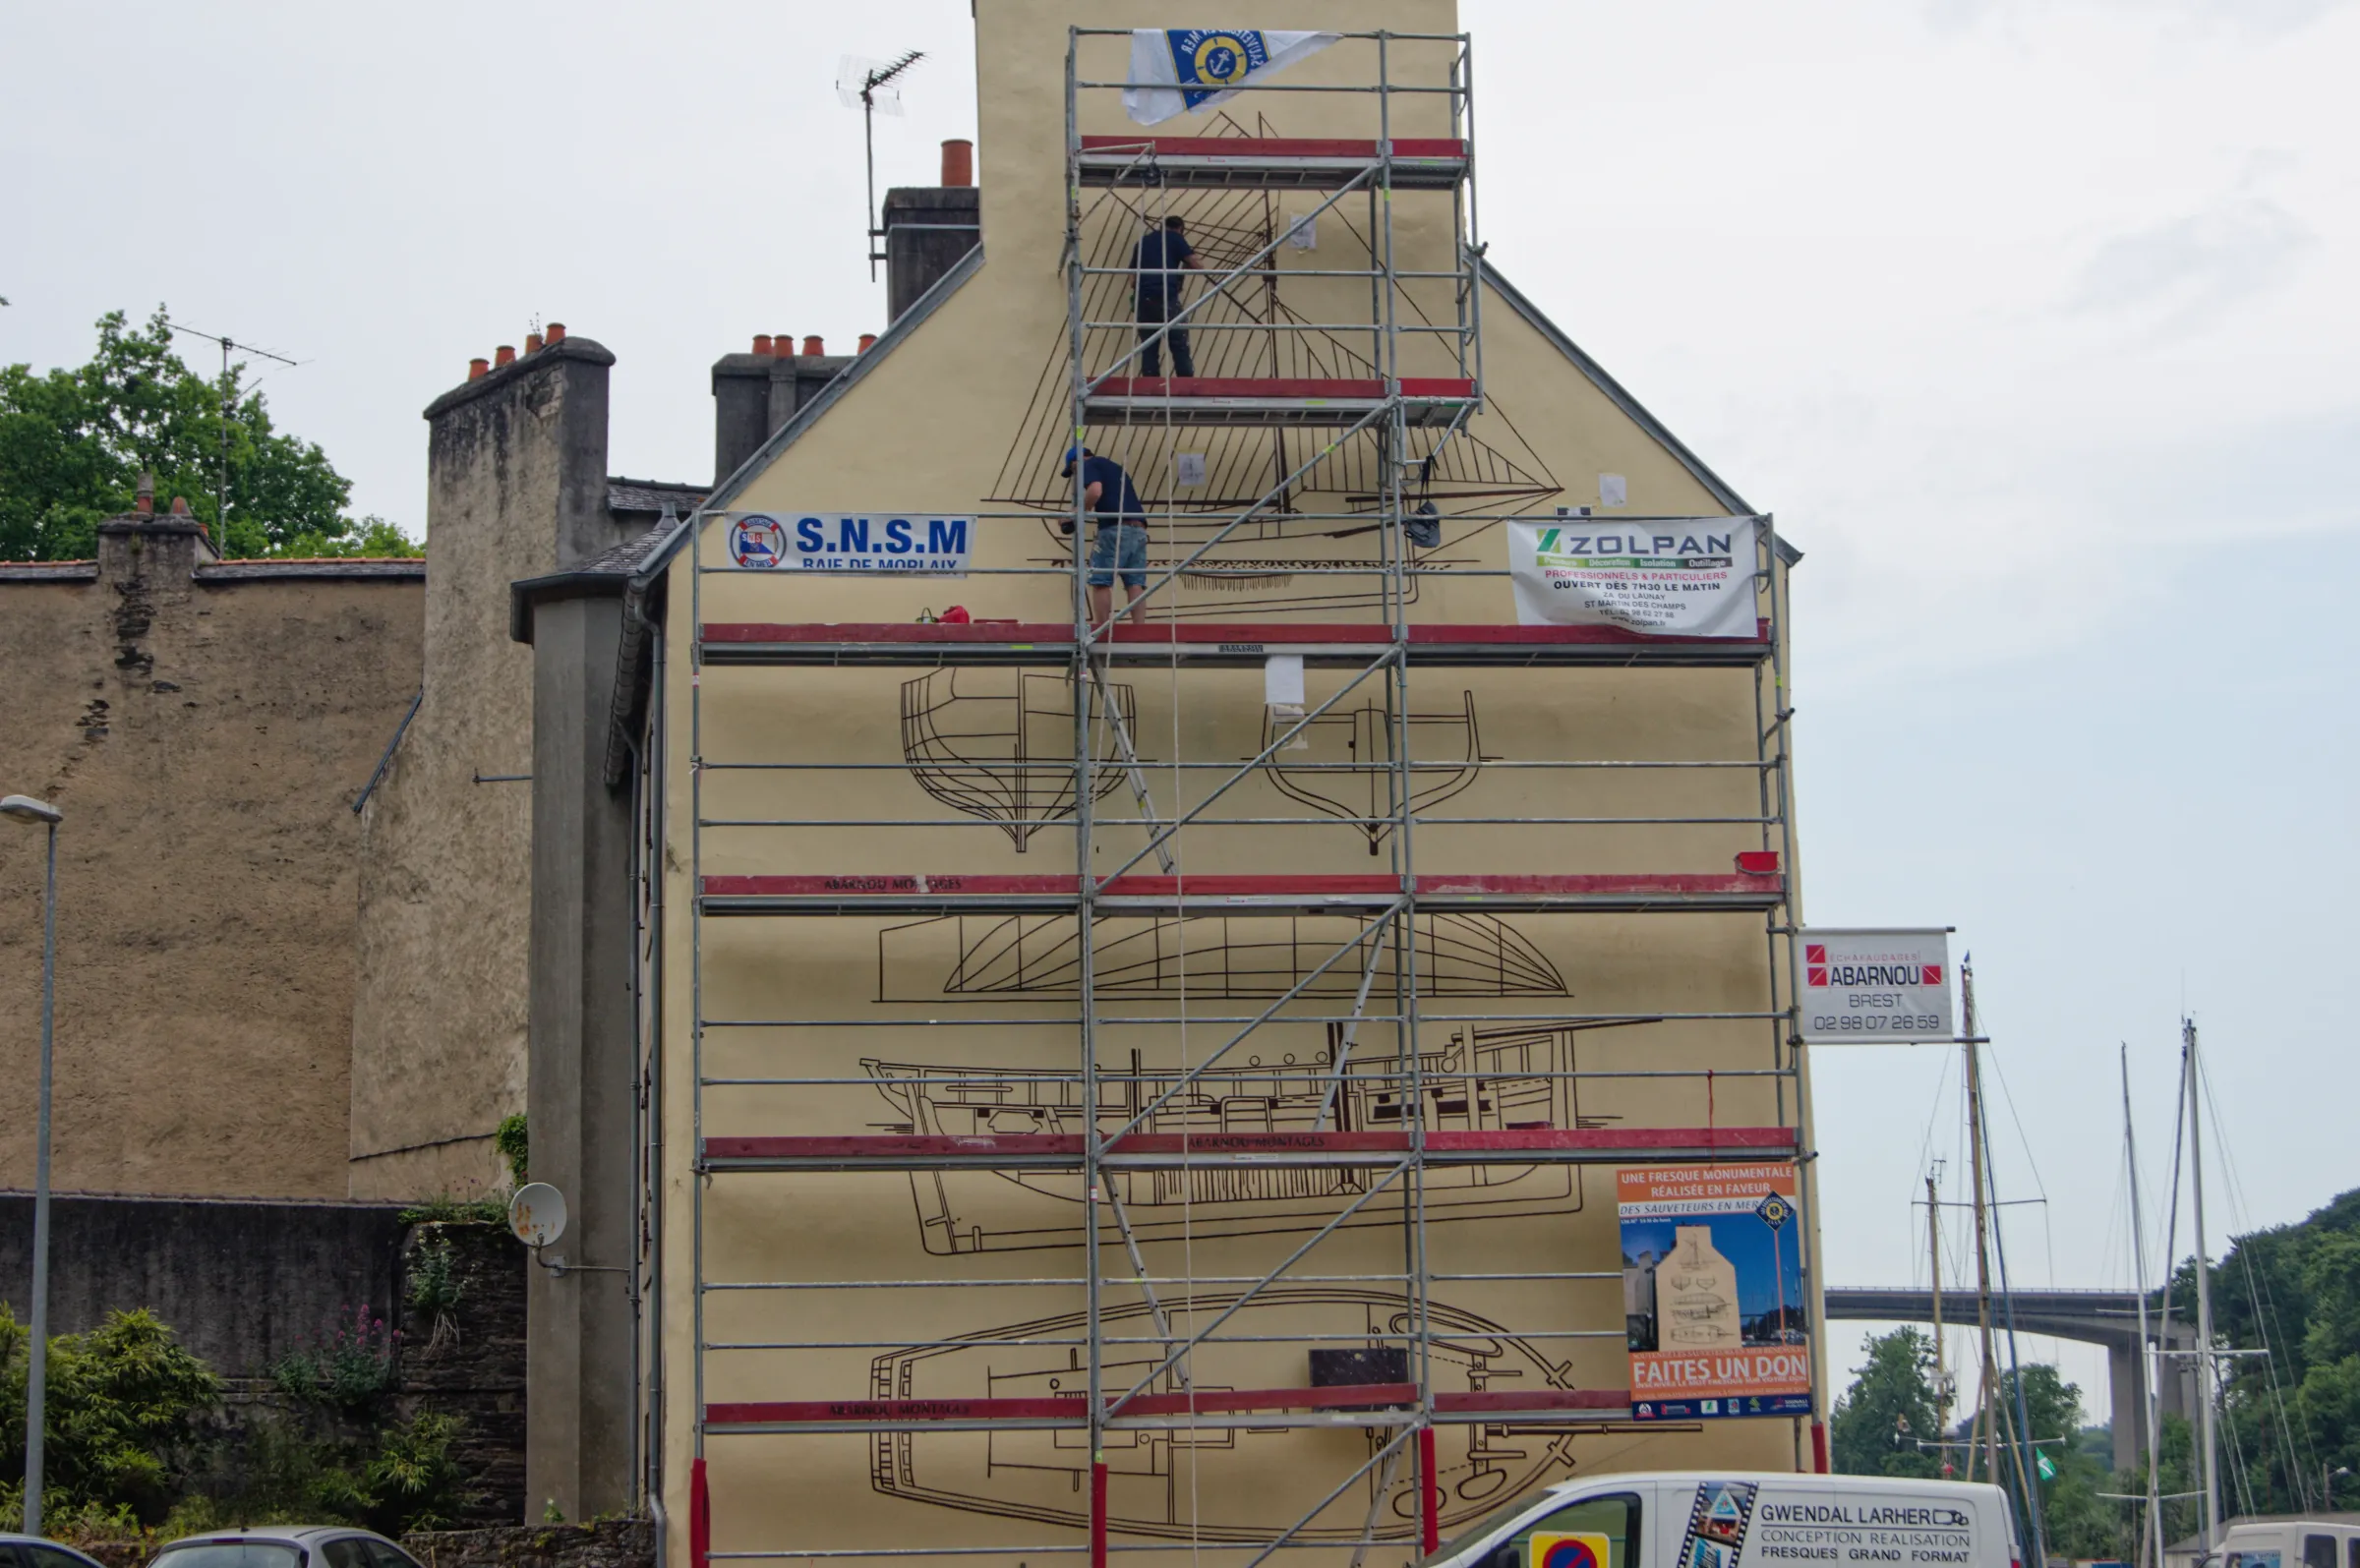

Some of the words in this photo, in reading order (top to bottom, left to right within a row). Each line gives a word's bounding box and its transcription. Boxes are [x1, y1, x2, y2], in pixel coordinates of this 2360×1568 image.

[796, 517, 968, 554] S.N.S.M
[1569, 534, 1732, 555] ZOLPAN
[1640, 558, 1677, 567] Isolation
[1688, 558, 1727, 568] Outillage
[1545, 569, 1638, 581] PROFESSIONNELS
[1652, 571, 1728, 581] PARTICULIERS
[1554, 580, 1602, 590] OUVERT
[1632, 582, 1662, 591] 7H30
[1664, 583, 1679, 592] LE
[1682, 582, 1721, 592] MATIN
[1651, 602, 1687, 610] CHAMPS
[1830, 965, 1919, 986] ABARNOU
[1849, 994, 1903, 1008] BREST
[1814, 1016, 1837, 1030] 02
[1840, 1016, 1862, 1030] 98
[1865, 1016, 1888, 1029] 07
[1891, 1016, 1914, 1029] 26
[1917, 1015, 1940, 1029] 59
[1622, 1172, 1645, 1184] UNE
[1648, 1171, 1700, 1183] FRESQUE
[1702, 1167, 1793, 1180] MONUMENTALE
[1651, 1184, 1704, 1197] RÉALISÉE
[1707, 1184, 1723, 1194] EN
[1726, 1183, 1771, 1194] FAVEUR
[1620, 1204, 1641, 1215] DES
[1644, 1202, 1714, 1214] SAUVETEURS
[1717, 1201, 1733, 1211] EN
[1735, 1200, 1758, 1211] MER
[1633, 1359, 1710, 1383] FAITES
[1716, 1358, 1750, 1380] UN
[1756, 1356, 1806, 1377] DON
[1761, 1504, 1853, 1524] GWENDAL
[1858, 1507, 1931, 1526] LARHER
[1761, 1529, 1862, 1544] CONCEPTION
[1870, 1532, 1971, 1547] REALISATION
[1761, 1546, 1839, 1560] FRESQUES
[1849, 1548, 1902, 1561] GRAND
[1912, 1550, 1970, 1563] FORMAT
